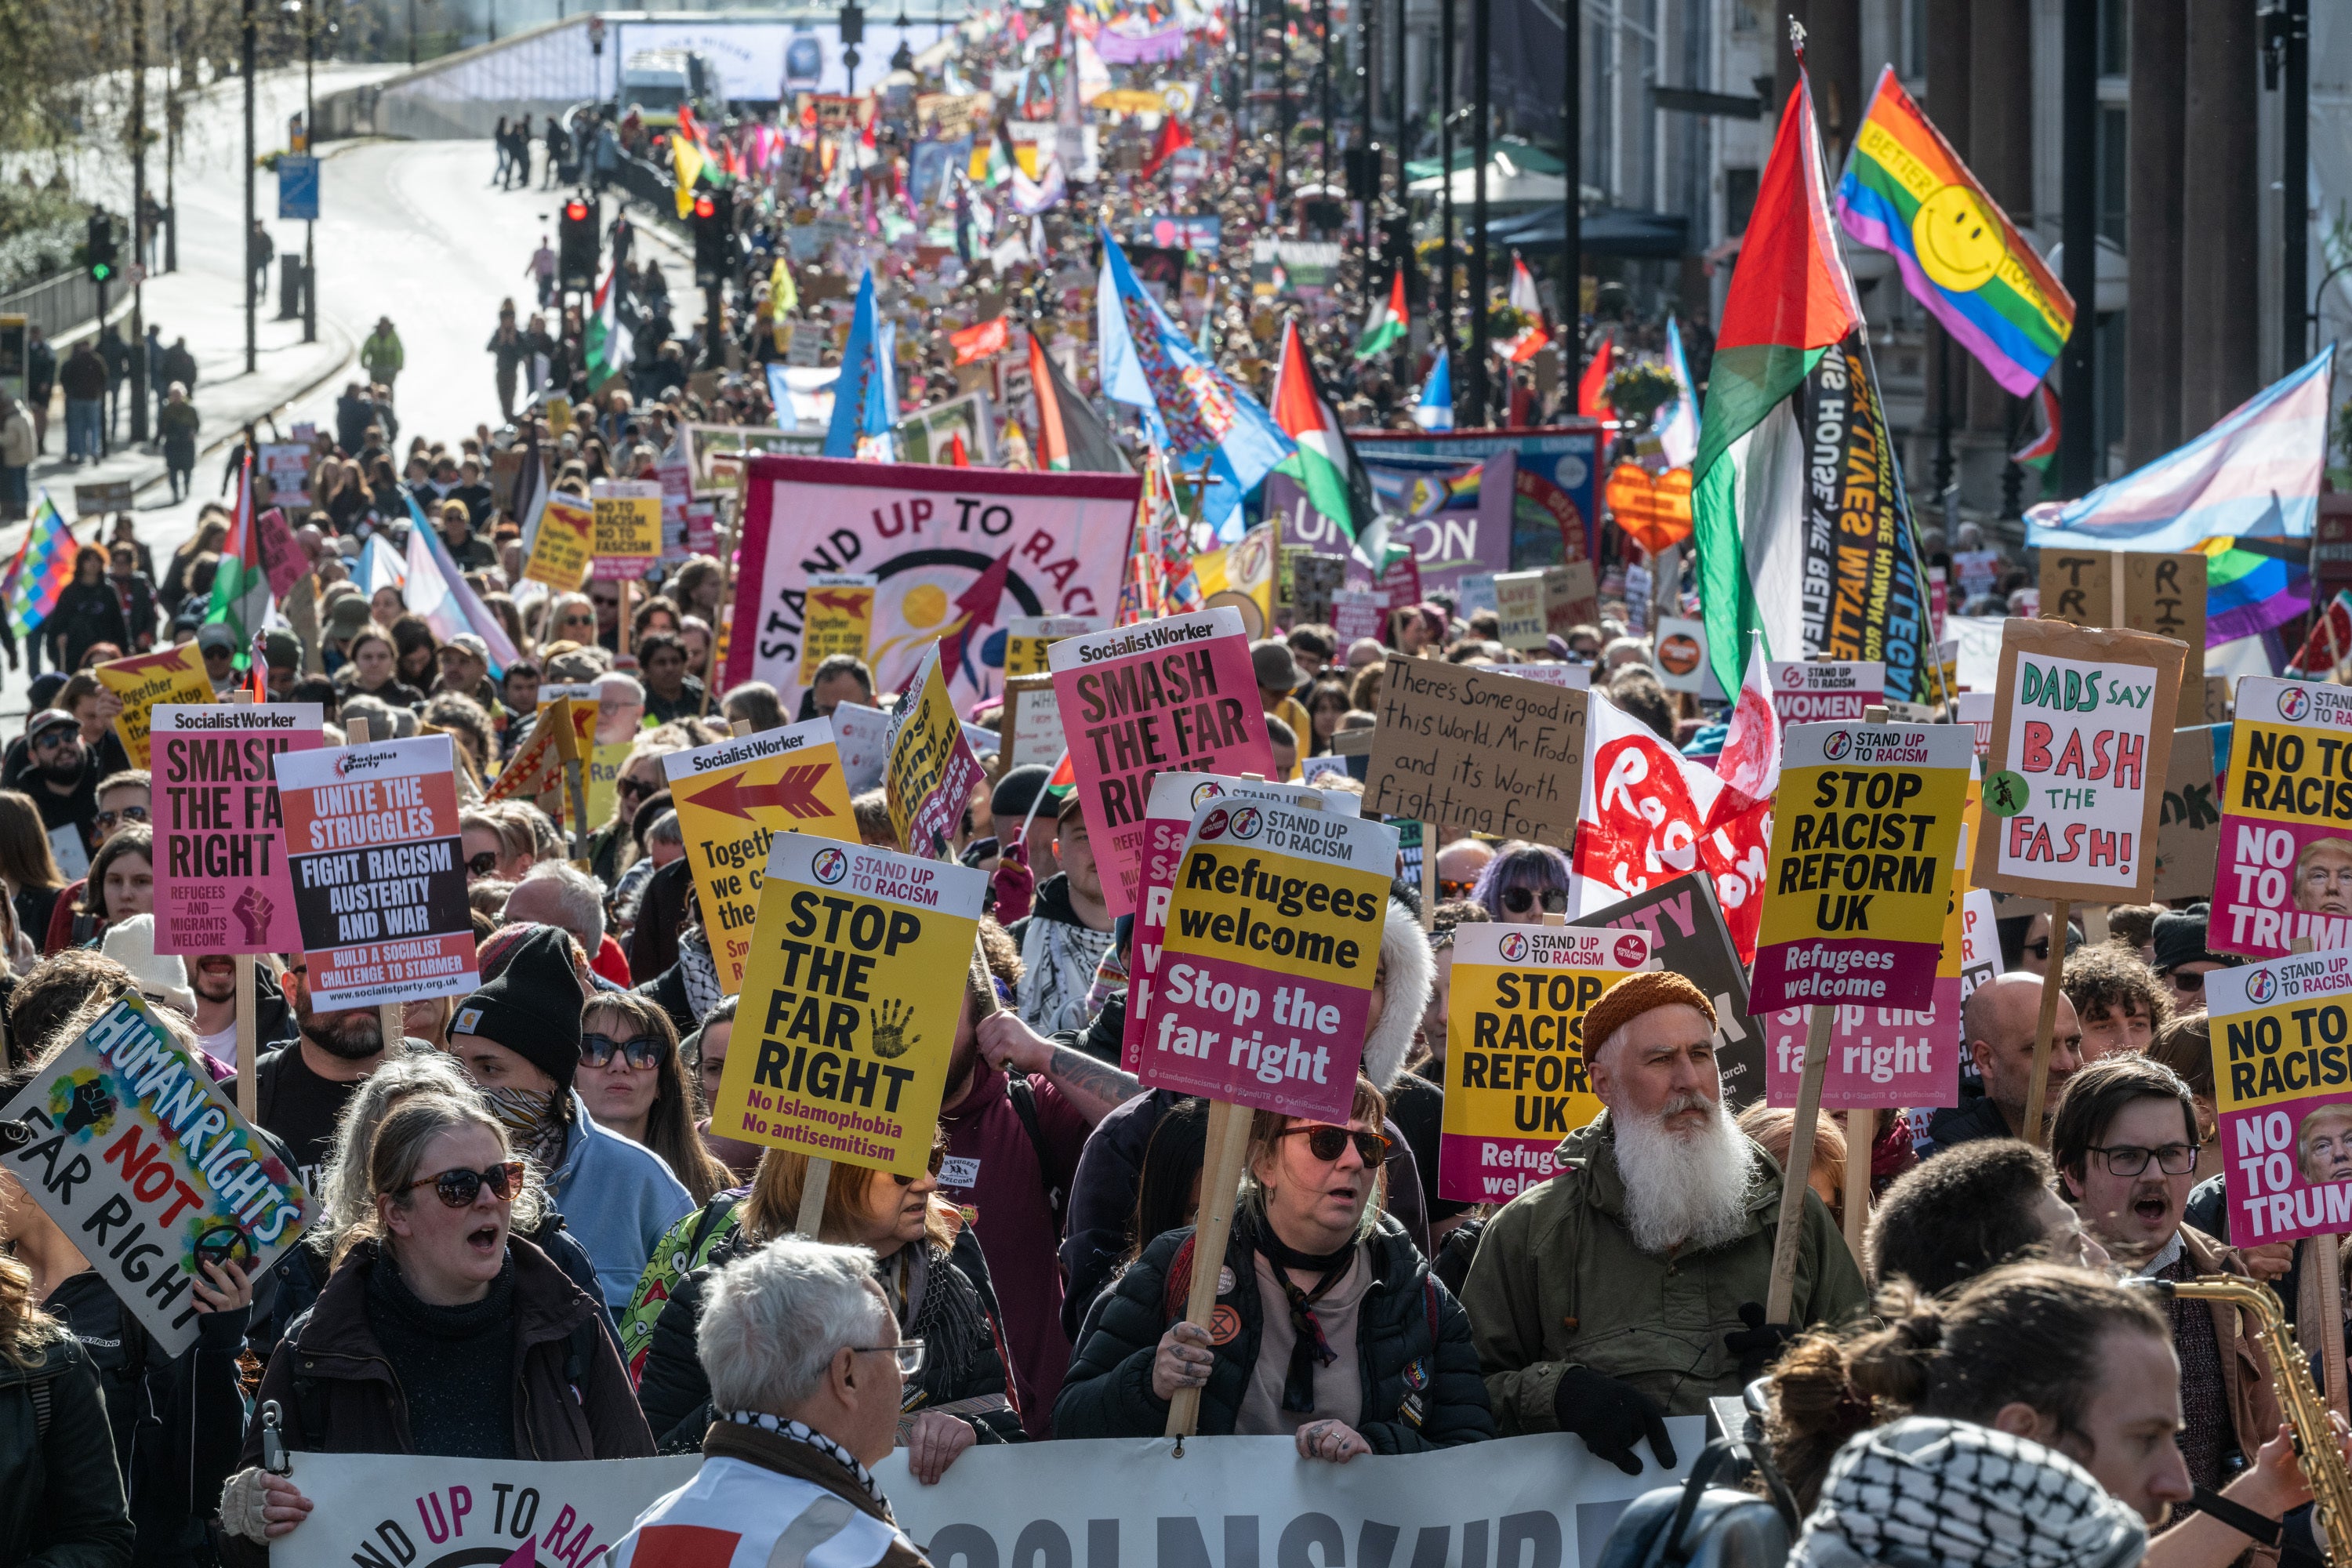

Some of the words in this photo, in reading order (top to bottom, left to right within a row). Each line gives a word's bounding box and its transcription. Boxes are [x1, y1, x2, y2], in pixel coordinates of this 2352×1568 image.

[1867, 129, 1933, 194] BETTER
[619, 502, 635, 510] TO
[873, 498, 933, 539] UP
[955, 498, 1012, 536] TO
[619, 528, 636, 538] TO
[1079, 629, 1153, 662] Socialist
[1152, 622, 1214, 649] Worker
[1076, 648, 1218, 724] SMASH
[1548, 670, 1561, 678] UP
[1807, 667, 1832, 677] STAND
[1838, 667, 1850, 677] UP
[1807, 679, 1818, 688] TO
[1821, 678, 1856, 688] RACISM
[2022, 662, 2102, 712] DADS
[2106, 680, 2151, 709] SAY
[1388, 659, 1457, 701] There's
[1461, 677, 1512, 710] Some
[1512, 695, 1559, 723] good
[1564, 704, 1584, 727] in
[1773, 695, 1862, 717] WOMEN
[175, 712, 239, 729] Socialist
[240, 712, 296, 728] Worker
[1385, 699, 1432, 735] this
[1496, 724, 1528, 753] Mr
[1534, 727, 1577, 764] Frodo
[2314, 708, 2332, 723] TO
[692, 744, 753, 772] Socialist
[753, 734, 805, 759] Worker
[1086, 714, 1167, 775] THE
[1172, 698, 1249, 757] FAR
[1855, 747, 1871, 761] TO
[1875, 748, 1928, 762] RACISM
[1856, 732, 1900, 746] STAND
[1904, 733, 1925, 746] UP
[2022, 721, 2143, 789] BASH
[2247, 730, 2304, 773] NO
[347, 751, 397, 765] Socialist
[1395, 749, 1438, 776] and
[1453, 753, 1483, 789] it's
[1495, 764, 1558, 802] Worth
[167, 787, 232, 829] THE
[245, 787, 284, 829] FA
[314, 782, 378, 818] UNITE
[382, 776, 424, 809] THE
[1813, 771, 1922, 809] STOP
[2045, 788, 2096, 809] THE
[2241, 770, 2352, 820] RACIS
[309, 807, 434, 850] STRUGGLES
[1265, 827, 1286, 847] TO
[1289, 836, 1353, 861] RACISM
[1268, 810, 1320, 835] STAND
[1324, 821, 1348, 840] UP
[1791, 812, 1936, 851] RACIST
[169, 833, 275, 877] RIGHT
[301, 853, 361, 888] FIGHT
[367, 842, 452, 880] RACISM
[2009, 817, 2132, 875] FASH!
[2236, 825, 2295, 869] NO
[711, 874, 742, 899] we
[852, 873, 872, 891] TO
[875, 878, 939, 906] RACISM
[854, 855, 907, 879] STAND
[911, 867, 935, 886] UP
[1185, 852, 1378, 922] Refugees
[1778, 853, 1936, 895] REFORM
[2234, 864, 2287, 908] TO
[171, 886, 225, 899] REFUGEES
[187, 902, 209, 915] AND
[330, 876, 430, 914] AUSTERITY
[170, 917, 227, 931] MIGRANTS
[339, 912, 379, 942] AND
[384, 905, 430, 936] WAR
[786, 891, 921, 956] STOP
[1817, 895, 1875, 931] UK
[172, 933, 226, 947] WELCOME
[333, 949, 367, 968] BUILD
[372, 947, 379, 963] A
[383, 939, 441, 962] SOCIALIST
[1180, 906, 1359, 969] welcome
[1532, 935, 1575, 949] STAND
[1580, 937, 1599, 949] UP
[1532, 949, 1548, 964] TO
[1552, 950, 1604, 966] RACISM
[321, 965, 385, 989] CHALLENGE
[389, 963, 403, 980] TO
[406, 956, 463, 978] STARMER
[780, 939, 877, 1003] THE
[1785, 944, 1894, 974] Refugees
[2281, 960, 2325, 981] STAND
[2328, 957, 2348, 973] UP
[329, 977, 458, 1001] www.socialistparty.org.uk
[1165, 964, 1261, 1025] Stop
[1272, 986, 1341, 1034] the
[1495, 972, 1602, 1012] STOP
[1785, 972, 1886, 1000] welcome
[2281, 981, 2299, 996] TO
[764, 989, 860, 1052] FAR
[2227, 1016, 2281, 1061] NO
[2292, 1005, 2347, 1047] TO
[1157, 1012, 1220, 1060] far
[1229, 1030, 1330, 1084] right
[1843, 1036, 1931, 1083] right
[753, 1039, 915, 1113] RIGHT
[1159, 1072, 1221, 1091] standuptoracismuk
[2230, 1044, 2352, 1102] RACIS
[85, 1000, 209, 1131] HUMAN
[179, 1105, 300, 1243] RIGHTS
[746, 1089, 772, 1110] No
[776, 1098, 903, 1138] Islamophobia
[1514, 1095, 1570, 1133] UK
[742, 1112, 768, 1134] No
[771, 1121, 895, 1162] antisemitism
[2236, 1111, 2292, 1157] NO
[16, 1105, 92, 1205] FAR
[944, 1160, 978, 1169] REFUGEES
[2239, 1152, 2292, 1196] TO
[103, 1124, 204, 1228] NOT
[940, 1174, 974, 1184] WELCOME
[2243, 1182, 2352, 1237] TRUM
[416, 1485, 472, 1544] UP
[492, 1483, 539, 1539] TO
